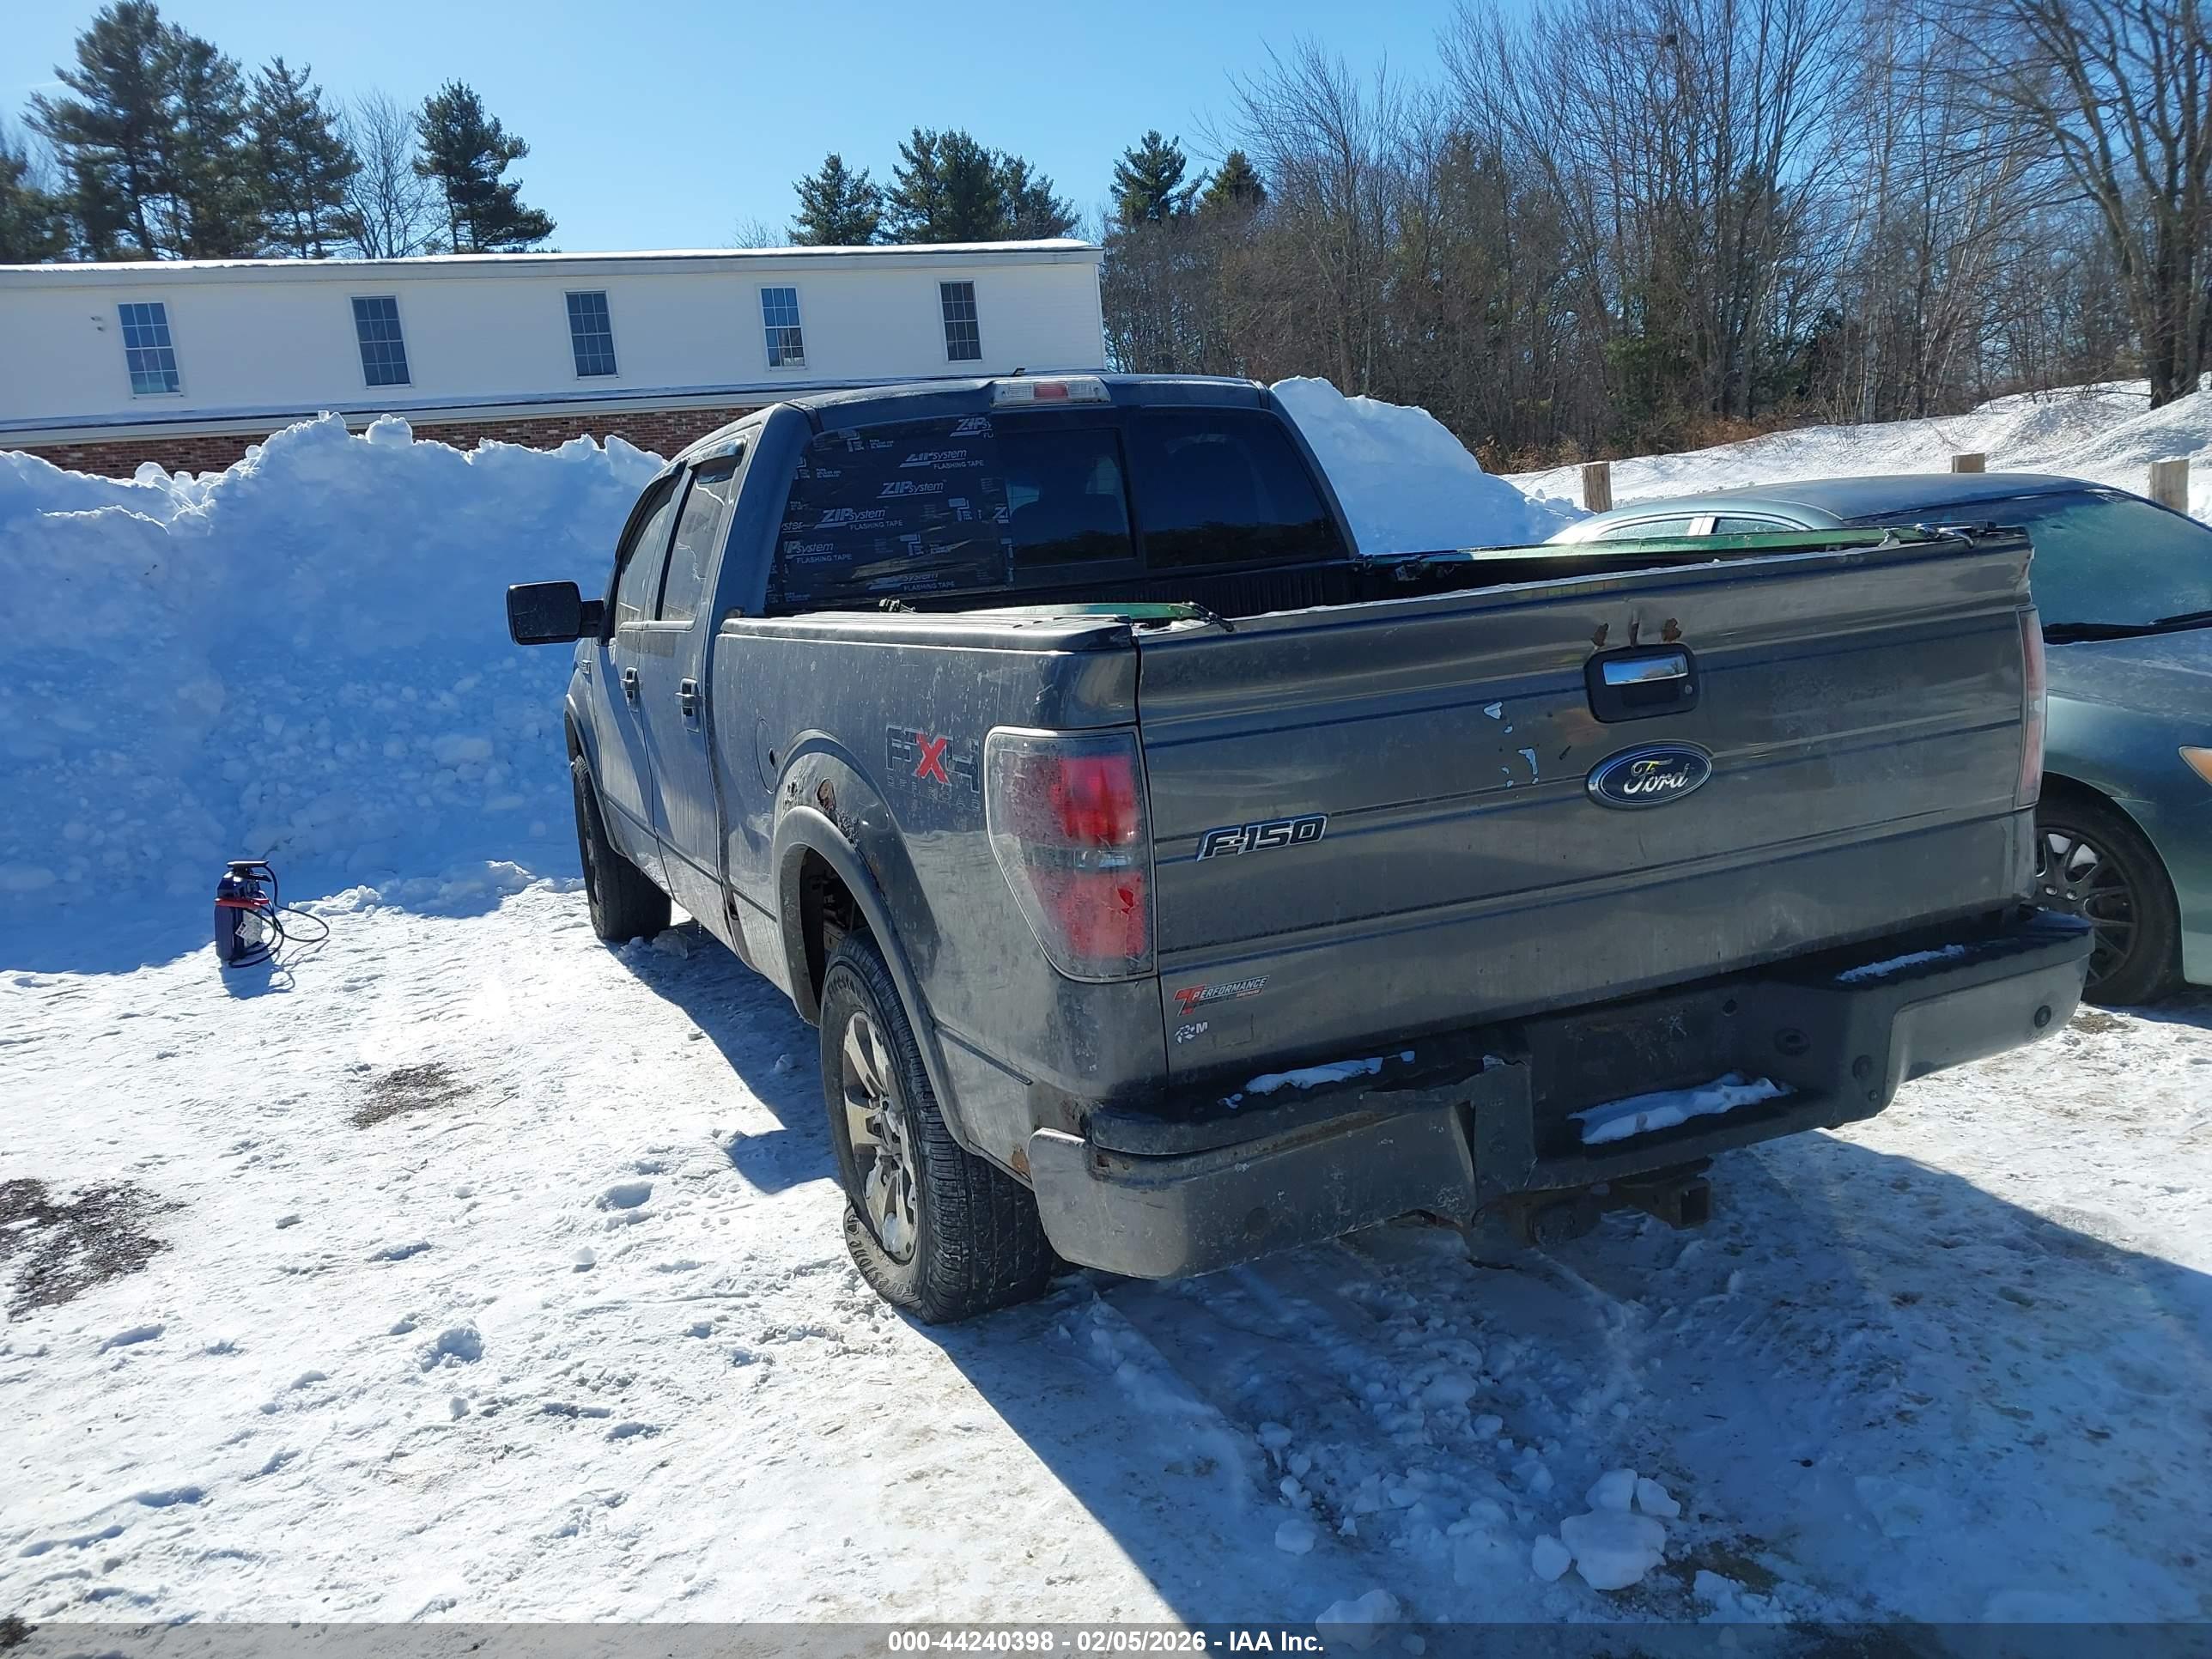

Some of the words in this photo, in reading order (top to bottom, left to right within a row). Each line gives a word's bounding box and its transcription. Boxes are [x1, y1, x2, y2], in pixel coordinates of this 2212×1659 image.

[933, 461, 966, 470] FLASHING
[850, 521, 884, 531] FLASHING
[796, 555, 832, 563] FLASHING
[886, 723, 980, 793] FX4
[1623, 758, 1691, 795] Ford
[1196, 814, 1328, 862] F-150
[1192, 976, 1267, 1000] PERFORMANCE
